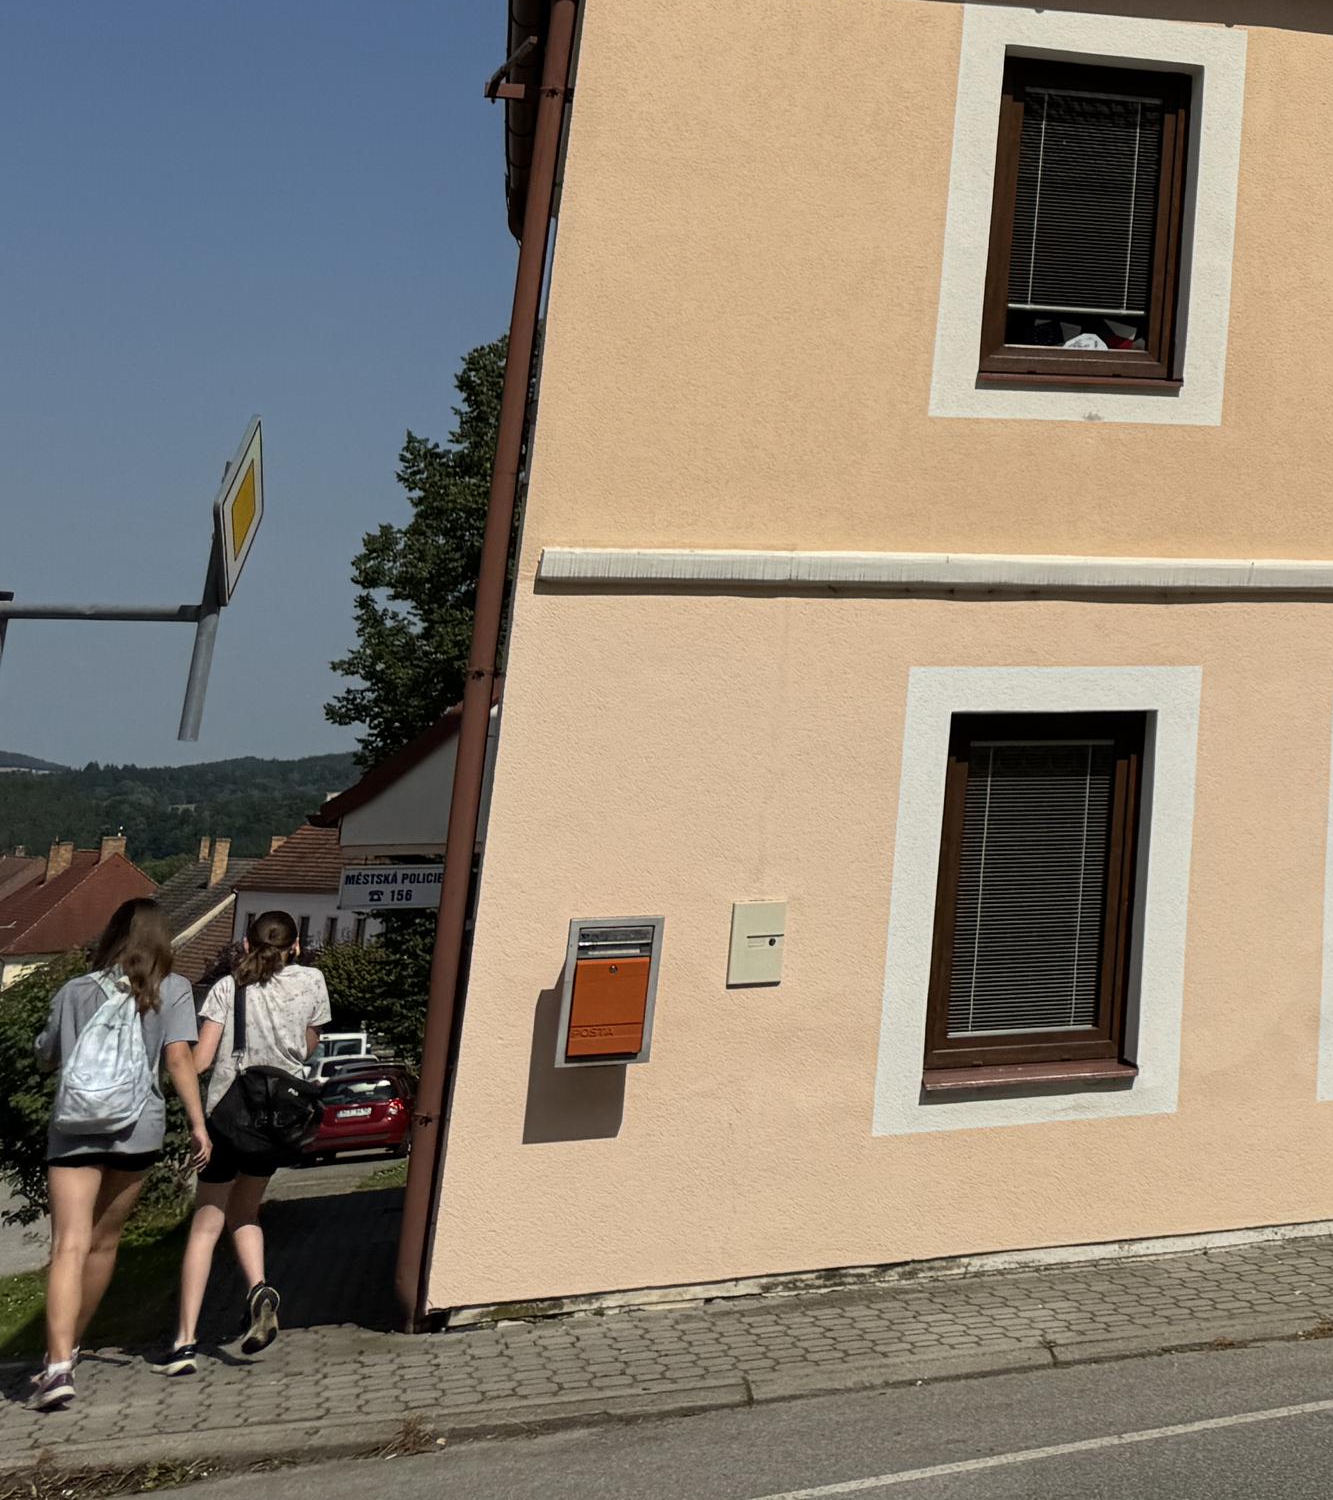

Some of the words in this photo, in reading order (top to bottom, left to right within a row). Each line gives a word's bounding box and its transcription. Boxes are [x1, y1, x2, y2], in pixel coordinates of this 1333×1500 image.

[344, 871, 398, 885] MĚSTSKÁ
[401, 872, 444, 884] POLICIE
[389, 889, 412, 902] 156
